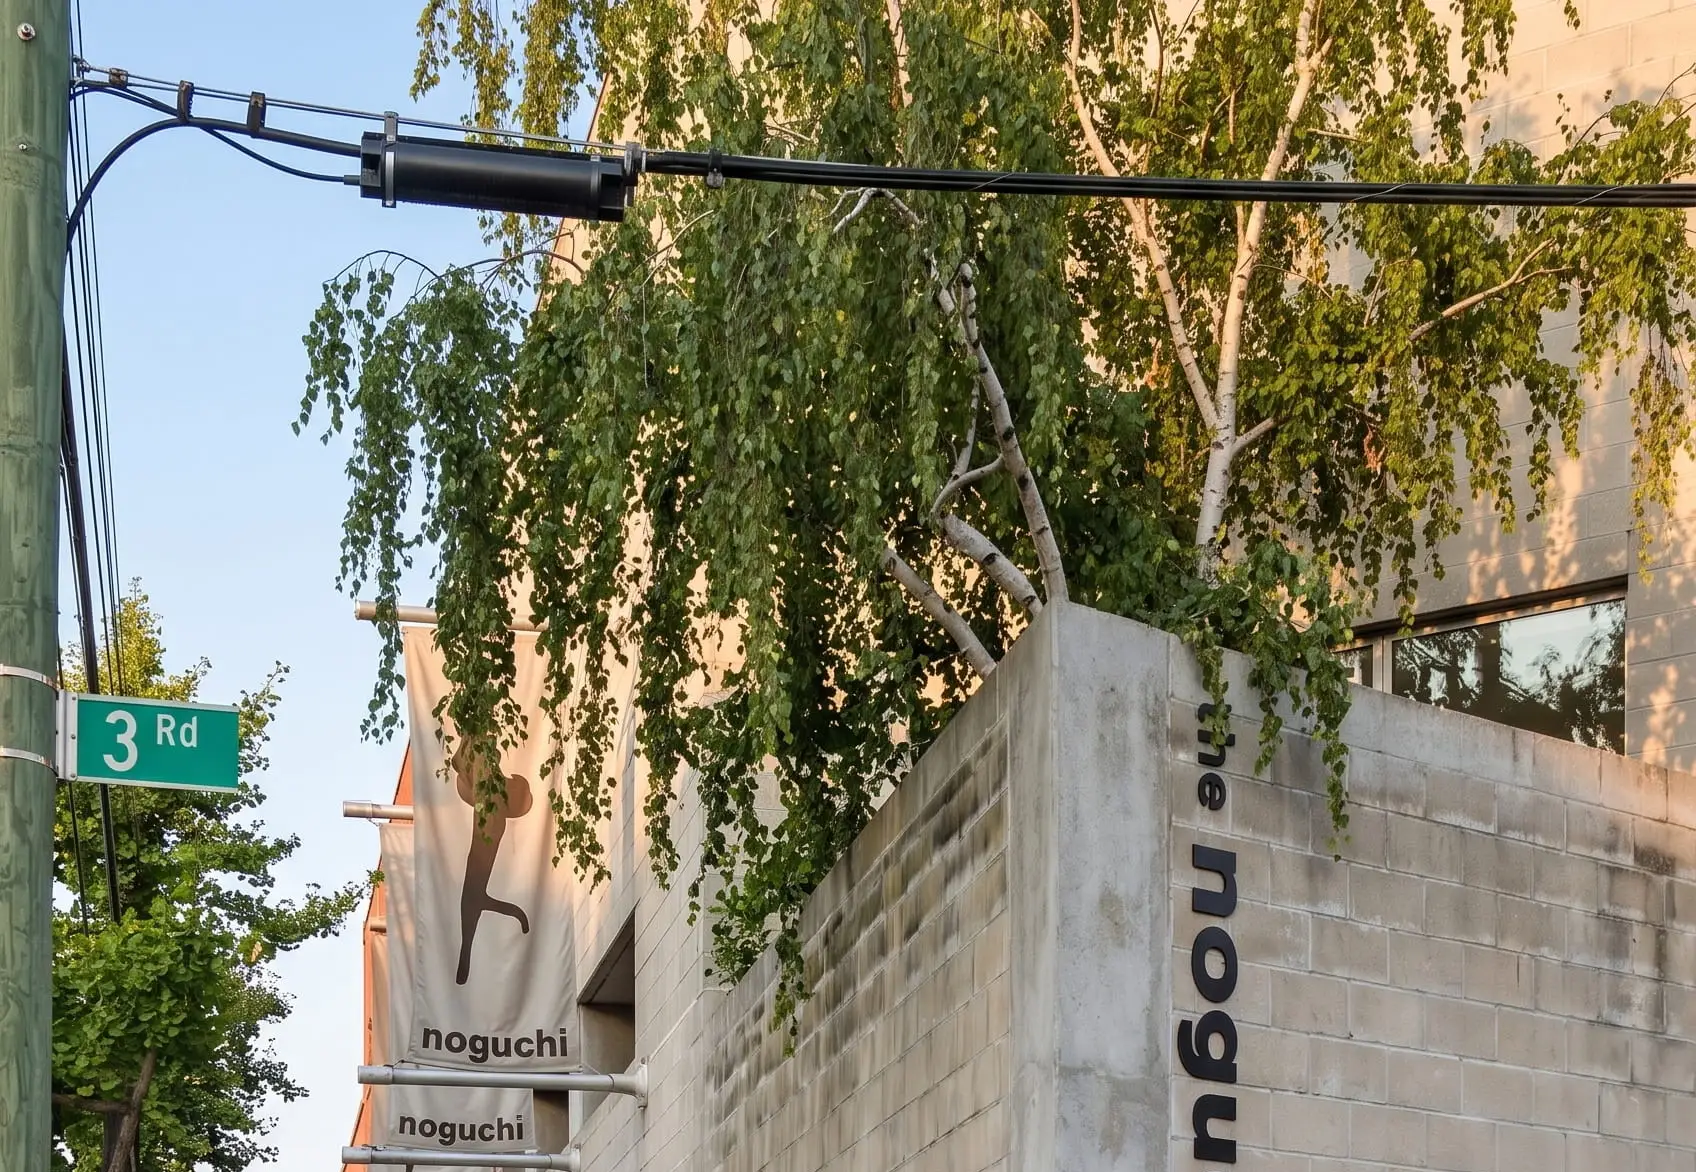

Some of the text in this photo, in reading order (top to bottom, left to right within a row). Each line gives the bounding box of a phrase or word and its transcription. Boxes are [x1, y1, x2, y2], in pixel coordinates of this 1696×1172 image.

[103, 710, 198, 772] 3 Rd
[422, 1027, 568, 1063] noguchi
[398, 1114, 524, 1146] noguchi
